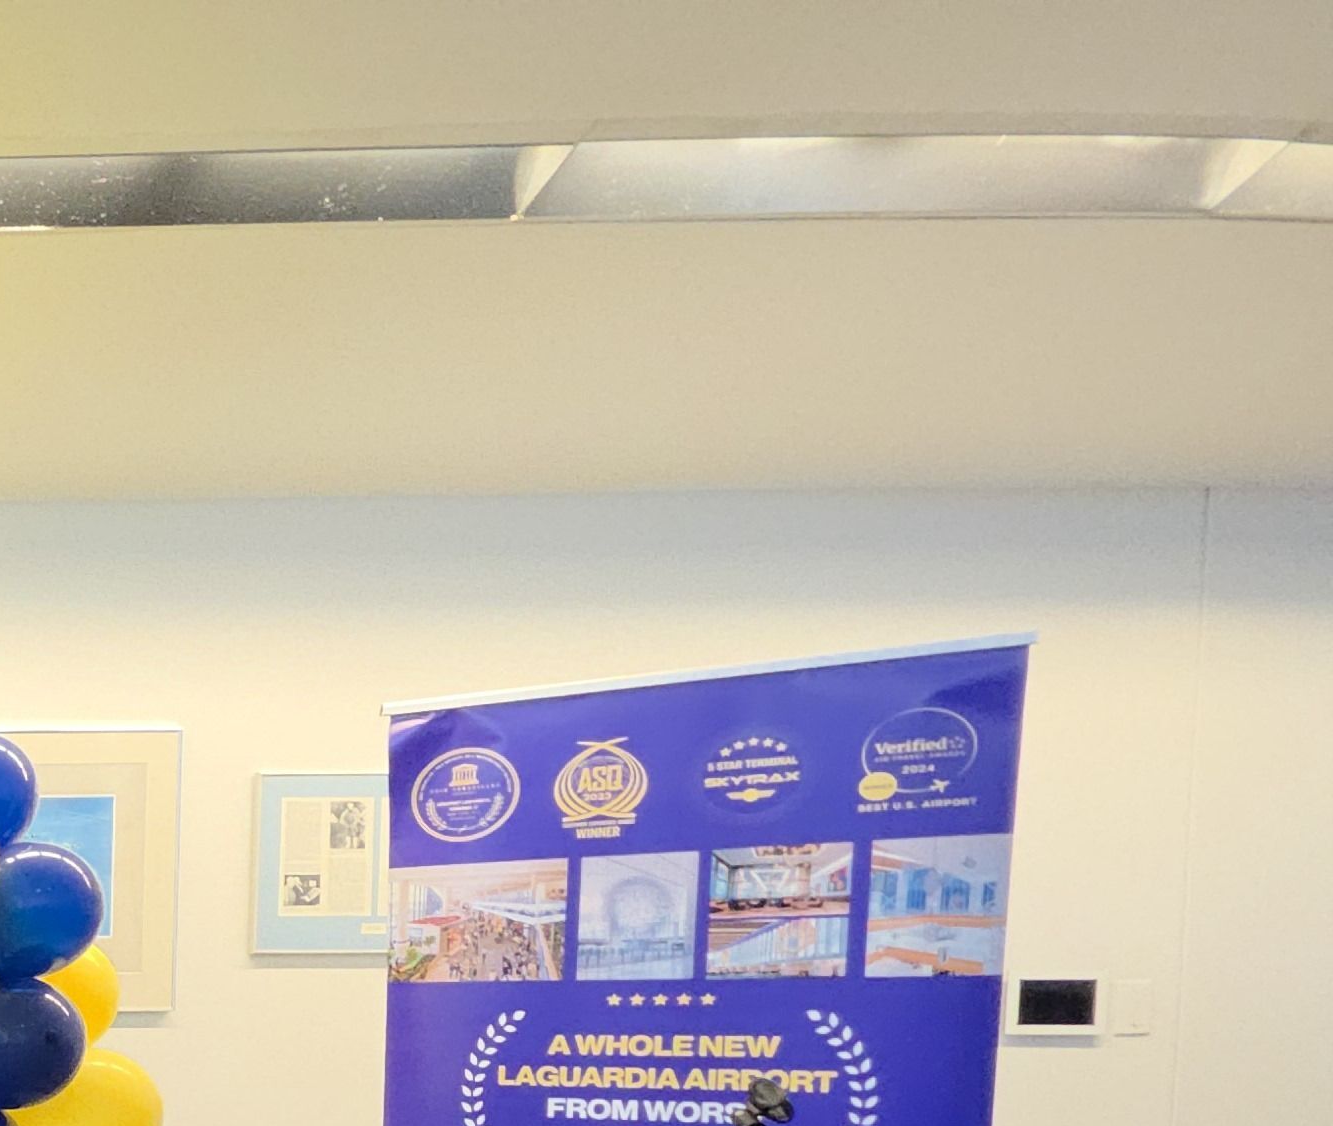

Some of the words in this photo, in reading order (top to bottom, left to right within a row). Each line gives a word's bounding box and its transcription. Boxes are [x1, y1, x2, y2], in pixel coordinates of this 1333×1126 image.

[874, 737, 949, 755] Verified
[746, 756, 798, 769] TERMINAL
[901, 764, 935, 775] 2024
[577, 765, 623, 793] ASQ
[704, 771, 801, 788] SKYTRAX
[857, 803, 888, 813] BEST
[893, 800, 916, 811] U.S.
[921, 797, 977, 809] AIRPORT
[576, 826, 620, 839] WINNER
[548, 1034, 571, 1056] A
[575, 1035, 694, 1056] WHOLE
[699, 1036, 781, 1058] NEW
[497, 1065, 680, 1089] LAGUARDIA
[546, 1098, 638, 1121] FROM
[643, 1101, 746, 1124] WORS
